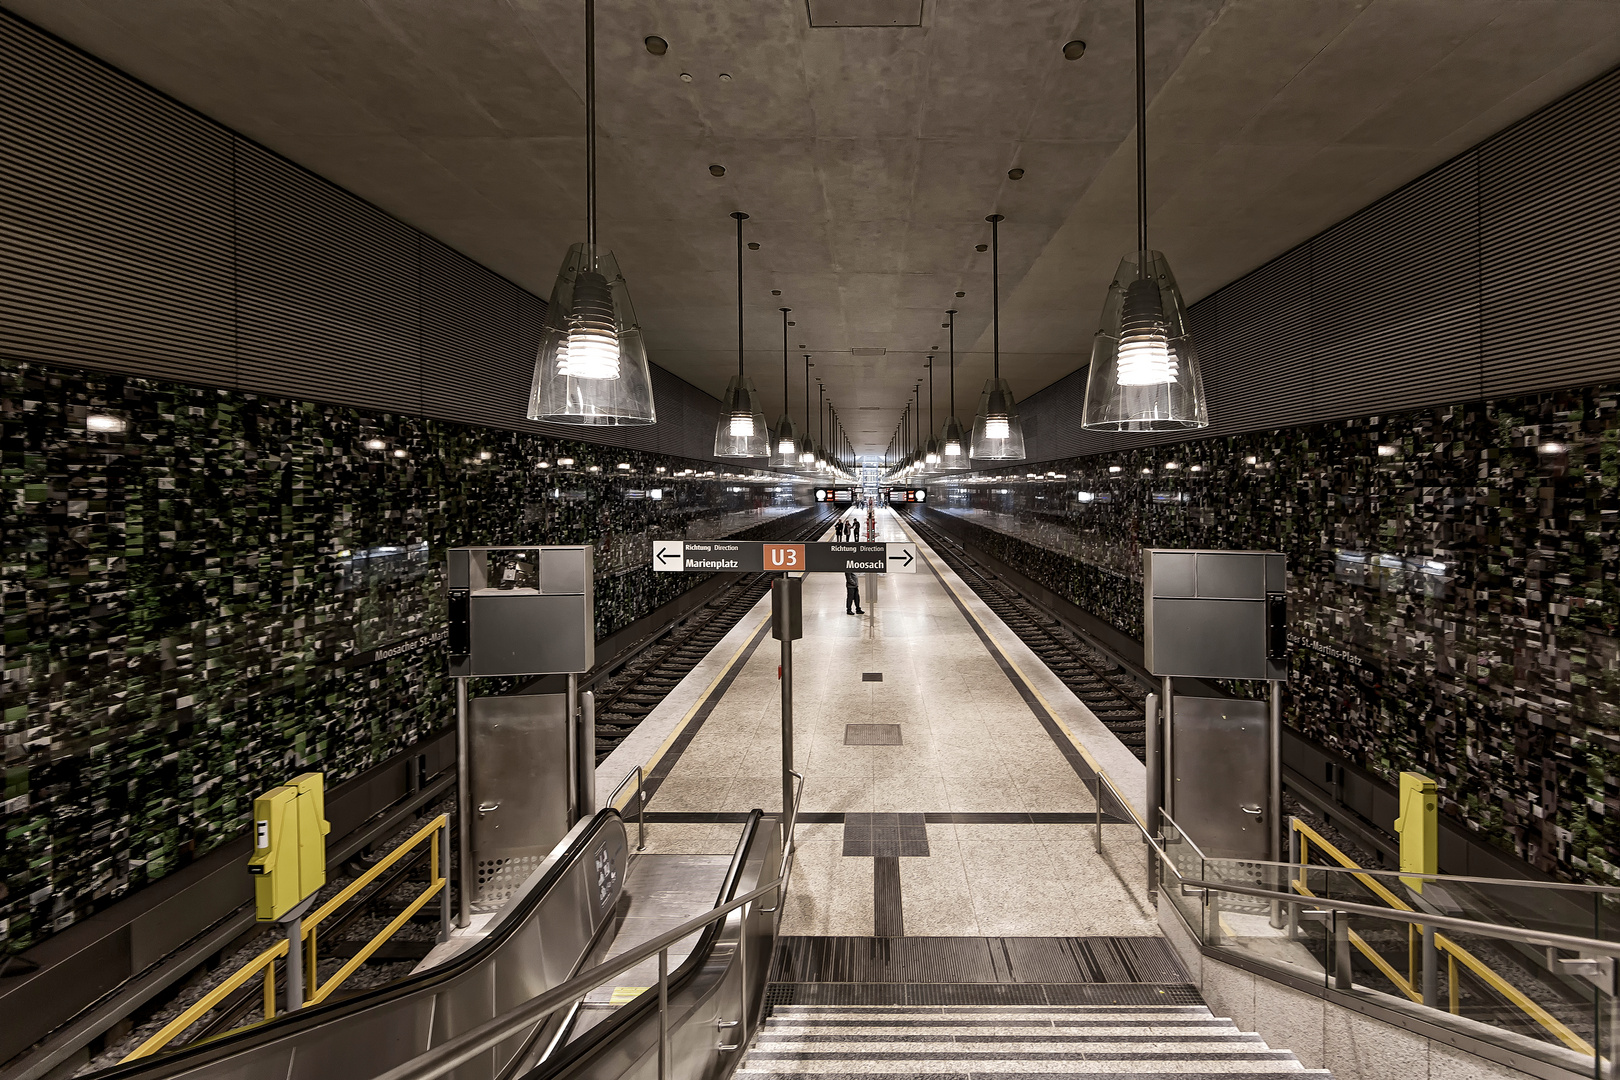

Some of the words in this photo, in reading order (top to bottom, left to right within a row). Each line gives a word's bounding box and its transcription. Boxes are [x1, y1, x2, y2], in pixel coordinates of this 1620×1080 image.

[685, 544, 711, 552] Richtung
[831, 545, 857, 553] Richtung
[771, 549, 797, 566] U3
[686, 559, 738, 569] Marienplatz
[846, 560, 884, 570] Moosach
[375, 641, 418, 660] Moosacher
[1301, 636, 1362, 666] St.-Martins-Platz
